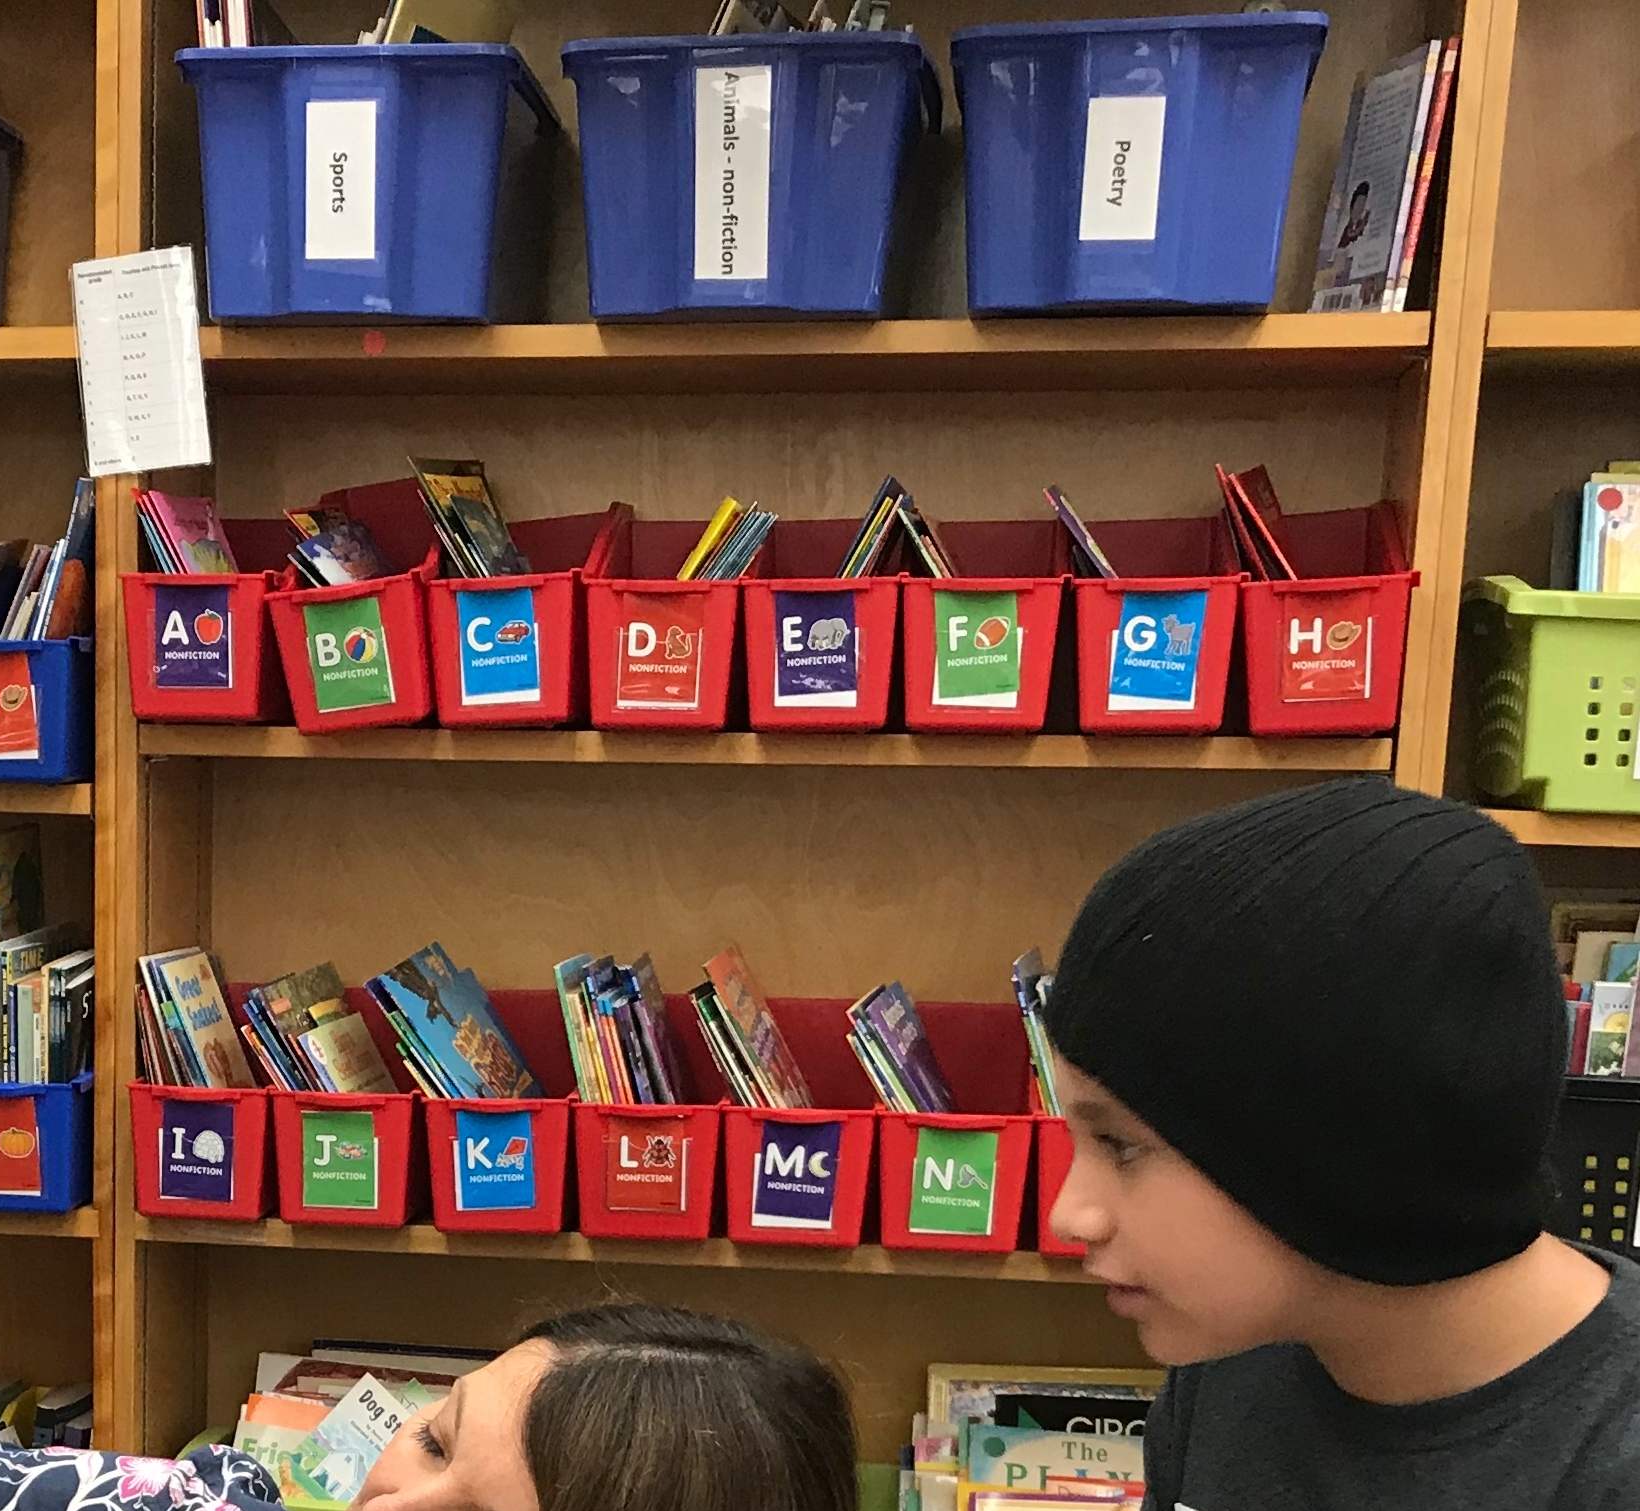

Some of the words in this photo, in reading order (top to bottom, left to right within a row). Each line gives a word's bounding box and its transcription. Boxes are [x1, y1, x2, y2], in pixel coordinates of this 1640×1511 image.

[722, 71, 740, 152] Animals
[332, 151, 348, 214] Sports
[1106, 140, 1131, 208] Poetry
[721, 169, 737, 276] non-fiction
[161, 611, 189, 646] A
[466, 617, 494, 653] C
[628, 622, 656, 657] D
[782, 617, 803, 651] E
[948, 615, 968, 651] F
[1123, 615, 1157, 652] G
[1289, 618, 1322, 655] H
[164, 650, 220, 661] NONFICTION
[317, 633, 341, 668] B
[471, 653, 528, 667] NONFICTION
[786, 654, 847, 668] NONFICTION
[946, 654, 1008, 668] NONFICTION
[1123, 657, 1186, 672] NONFICTION
[1292, 659, 1356, 671] NONFICTION
[322, 668, 378, 682] NONFICTION
[628, 662, 687, 674] NONFICTION
[171, 1127, 186, 1160] I
[314, 1135, 337, 1167] J
[466, 1137, 490, 1170] K
[619, 1136, 639, 1168] L
[764, 1142, 806, 1177] M
[169, 1164, 223, 1177] NONFICTION
[312, 1171, 367, 1181] NONFICTION
[469, 1174, 525, 1183] NONFICTION
[616, 1173, 673, 1184] NONFICTION
[922, 1158, 955, 1191] N
[767, 1181, 825, 1195] NONFICTION
[921, 1195, 981, 1208] NONFICTION
[359, 1389, 385, 1421] Dog
[384, 1413, 402, 1435] St
[1062, 1440, 1108, 1463] The
